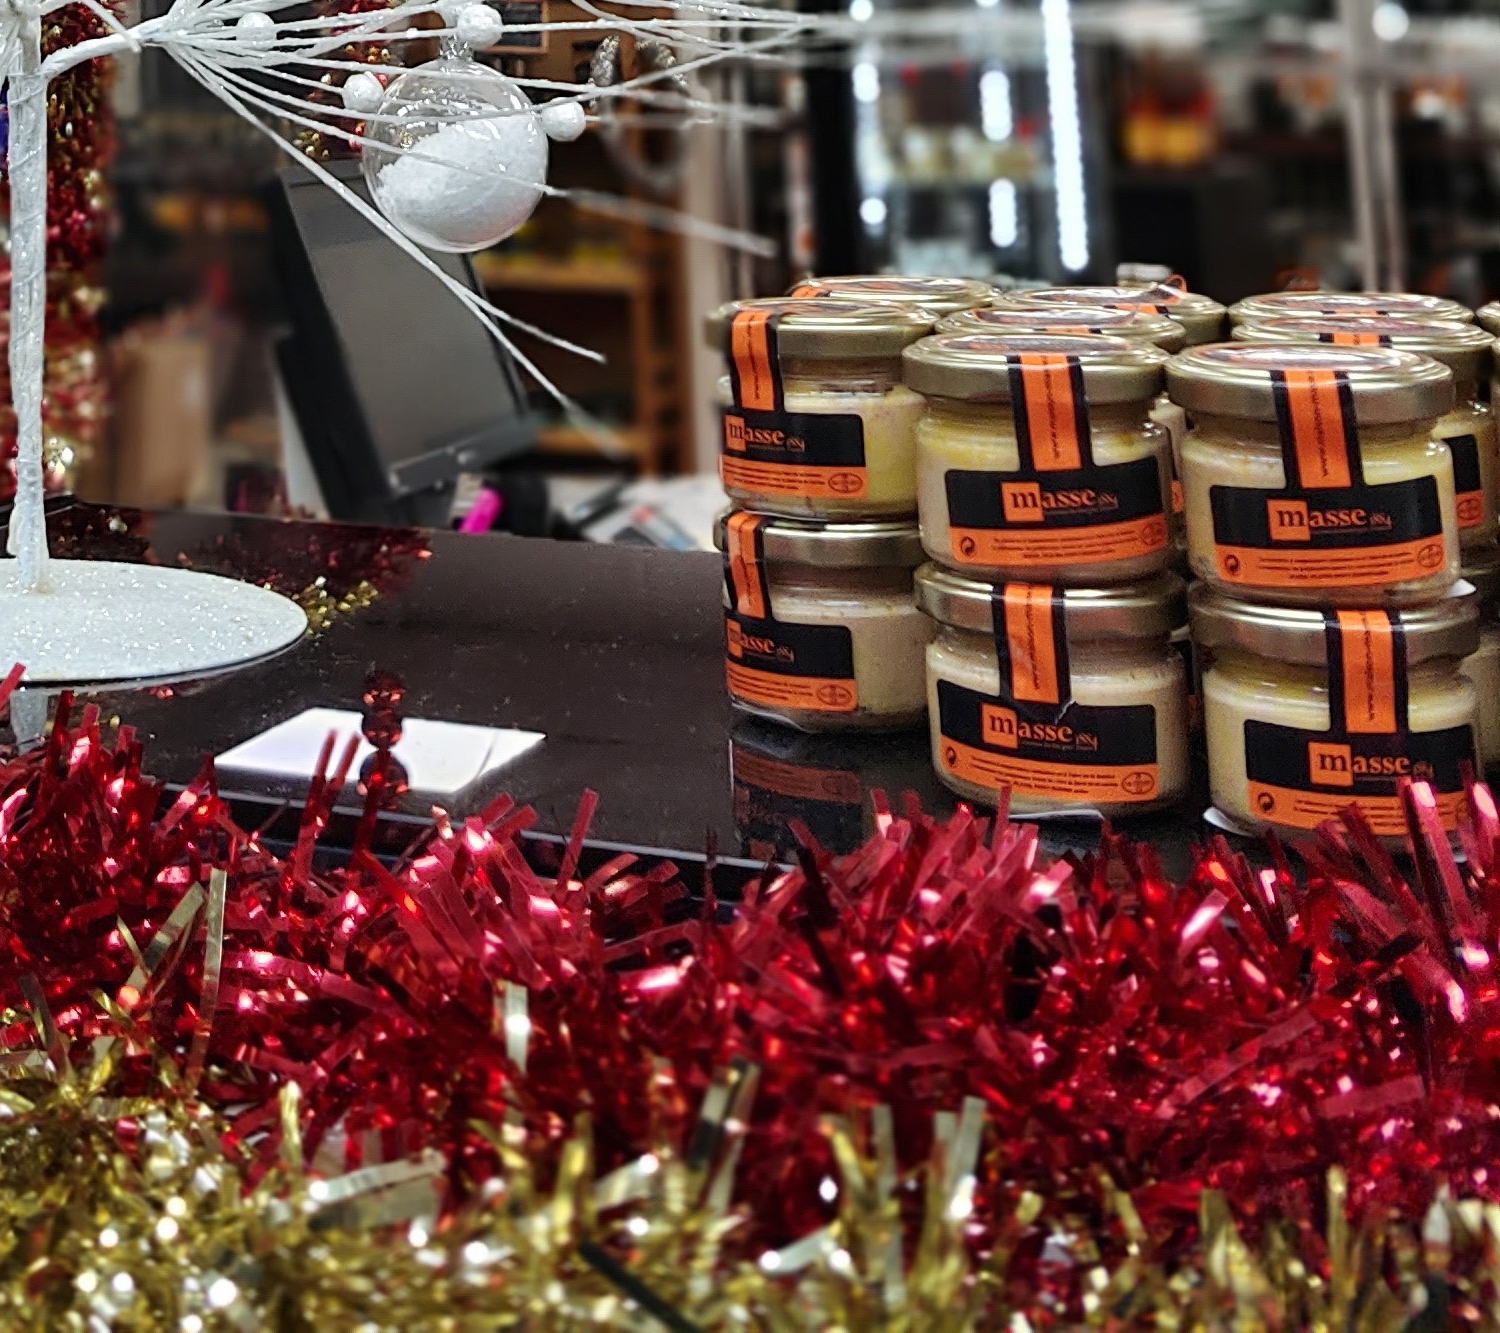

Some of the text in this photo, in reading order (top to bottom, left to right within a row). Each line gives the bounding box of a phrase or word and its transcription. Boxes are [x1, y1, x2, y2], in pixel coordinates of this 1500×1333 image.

[729, 423, 785, 445] masse
[1010, 488, 1097, 509] masse
[1276, 508, 1368, 528] masse
[989, 714, 1074, 742] masse
[1317, 753, 1412, 775] masse
